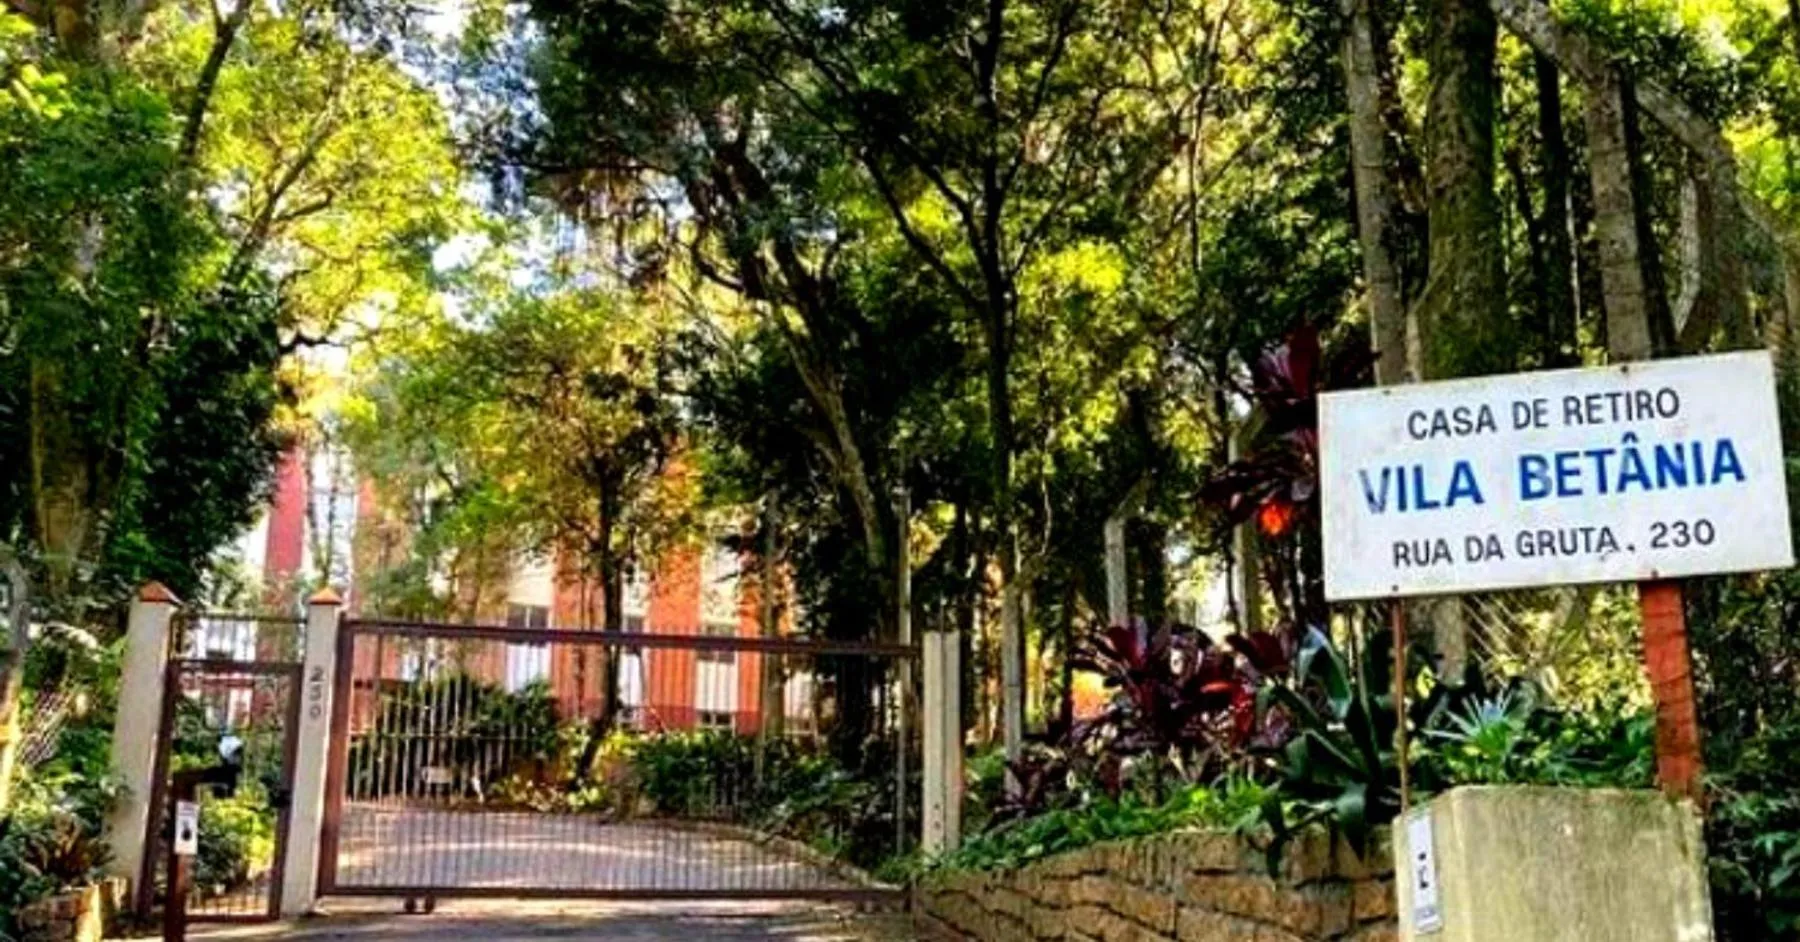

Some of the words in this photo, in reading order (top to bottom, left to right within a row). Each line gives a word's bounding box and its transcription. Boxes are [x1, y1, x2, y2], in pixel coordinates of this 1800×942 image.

[1408, 406, 1496, 440] CASA
[1513, 398, 1549, 429] DE
[1564, 387, 1681, 426] RETIRO
[1359, 459, 1484, 514] VILA
[1518, 432, 1746, 502] BETÂNIA
[1393, 538, 1453, 568] RUA
[1466, 533, 1505, 562] DA
[1650, 518, 1715, 549] 230
[309, 666, 324, 719] 230
